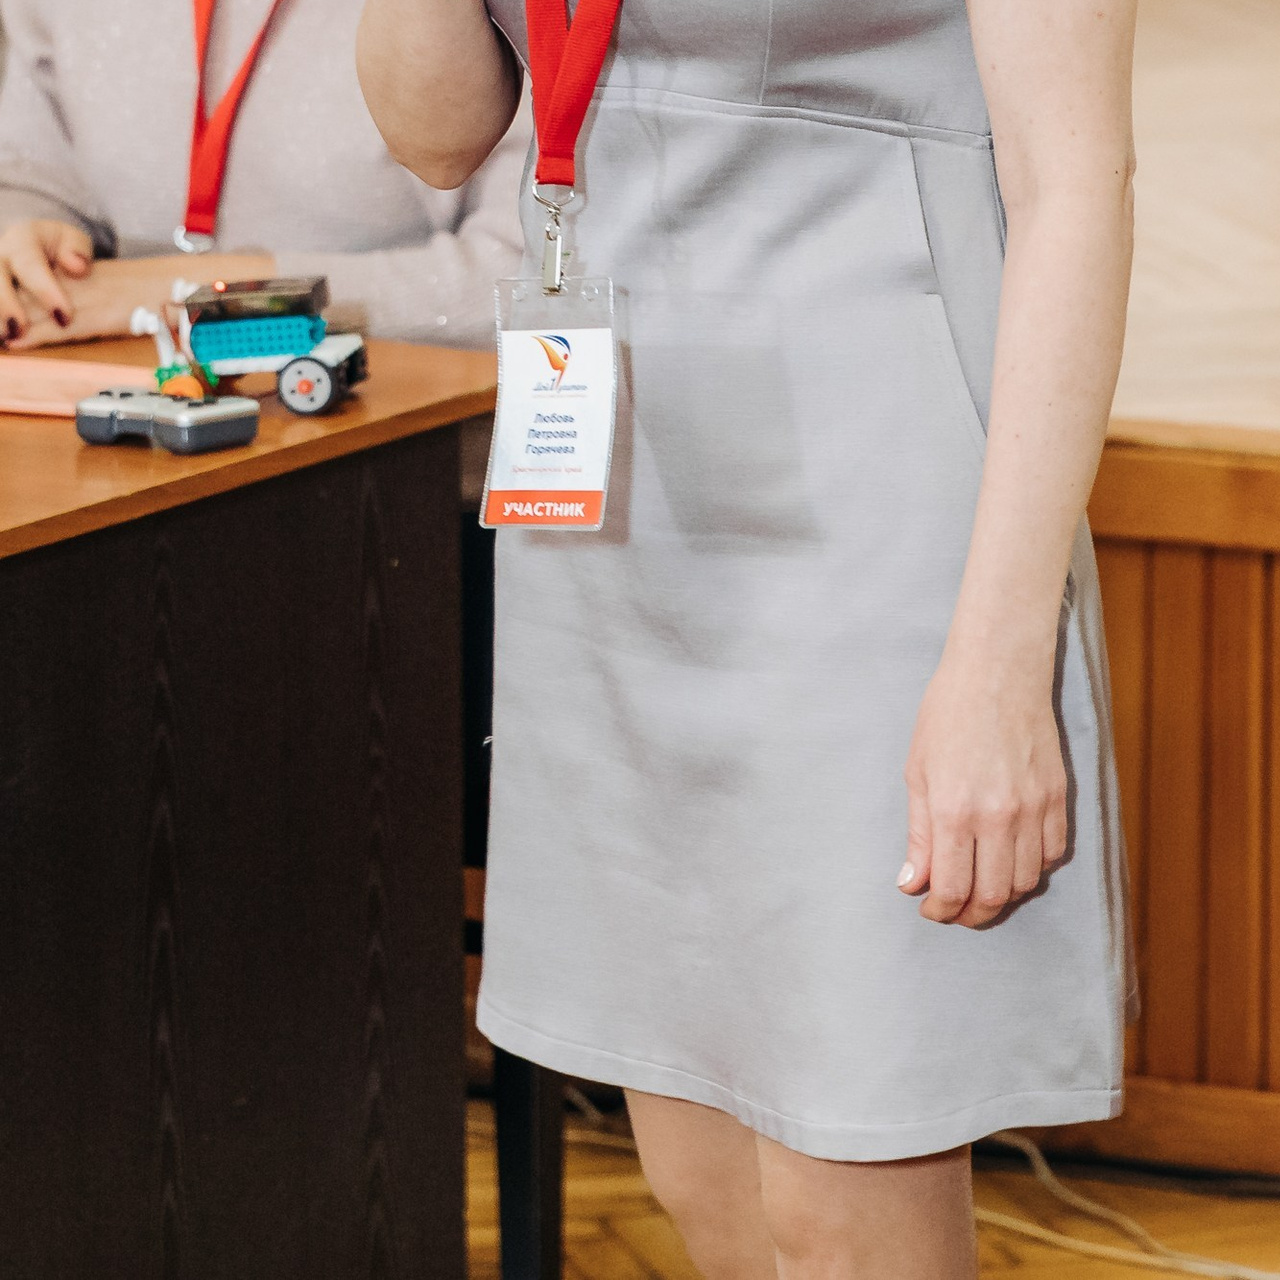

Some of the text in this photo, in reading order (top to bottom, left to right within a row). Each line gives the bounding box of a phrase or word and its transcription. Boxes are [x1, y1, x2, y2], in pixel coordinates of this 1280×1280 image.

[534, 412, 575, 423] Любовь
[527, 428, 577, 440] Петровна
[525, 443, 576, 455] Горячева
[502, 502, 586, 517] УЧАСТНИК
